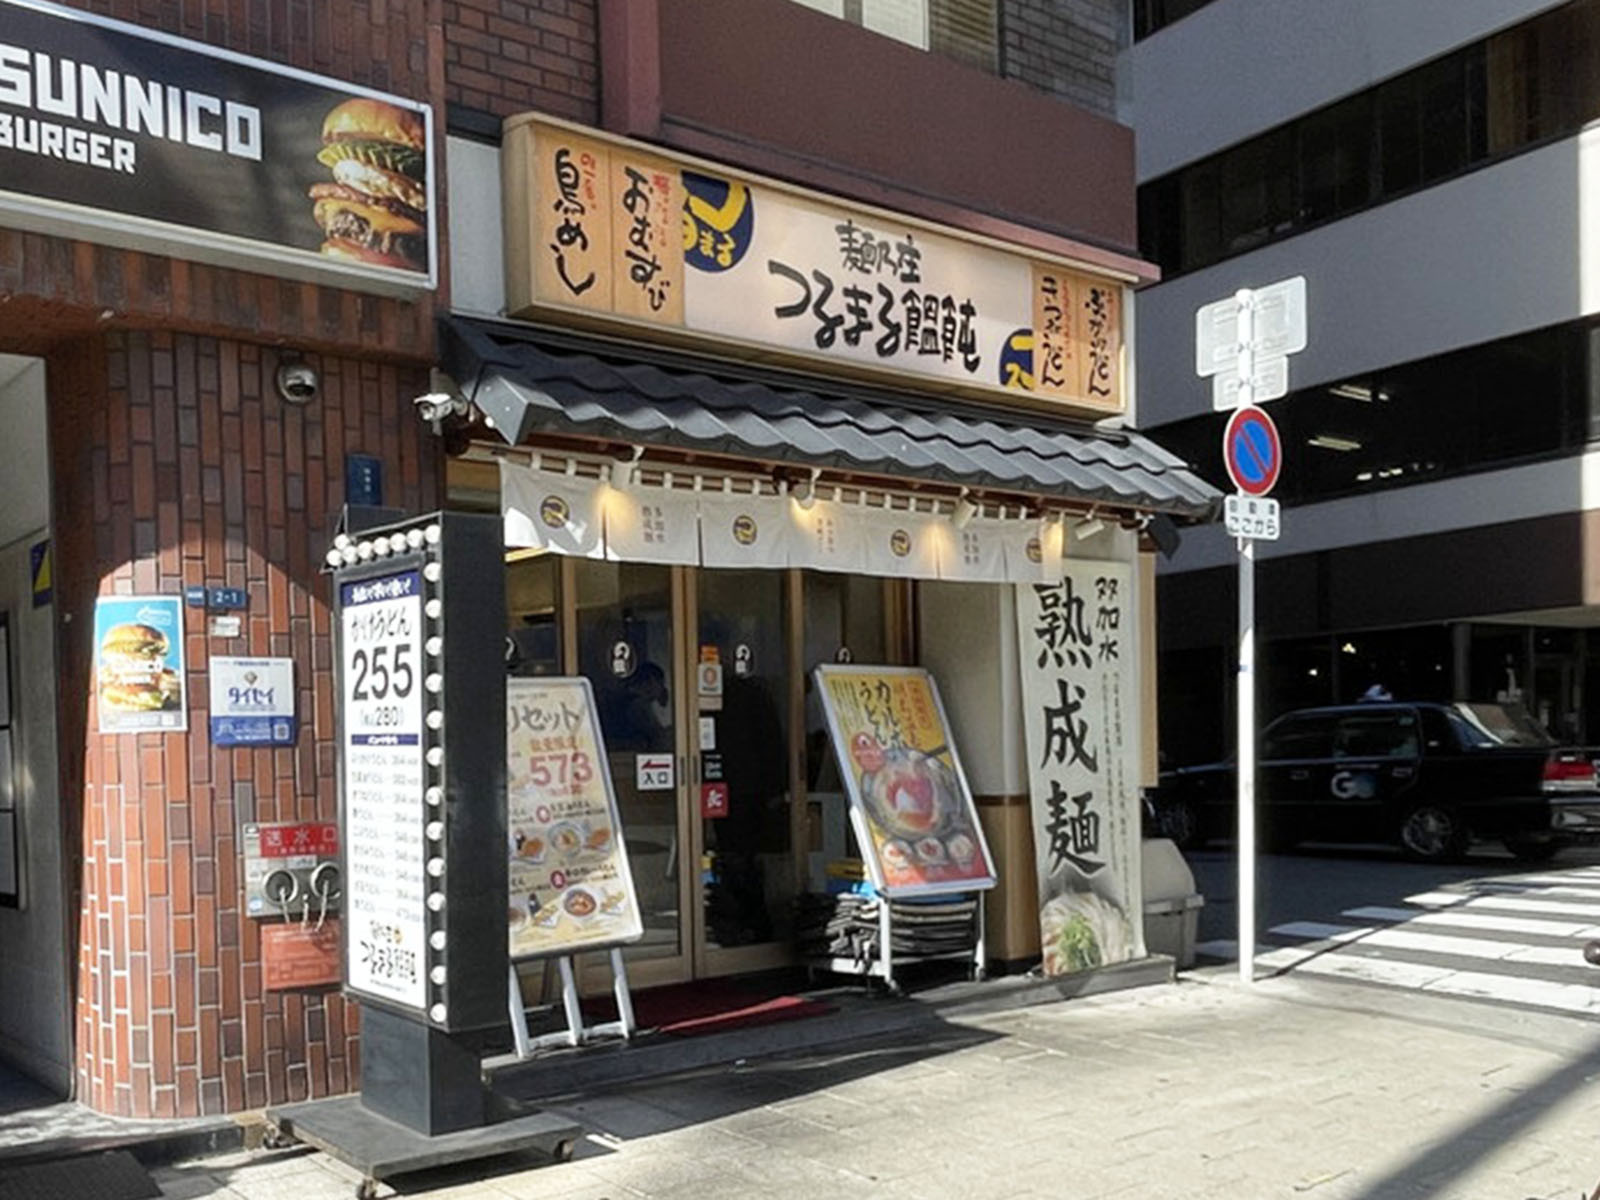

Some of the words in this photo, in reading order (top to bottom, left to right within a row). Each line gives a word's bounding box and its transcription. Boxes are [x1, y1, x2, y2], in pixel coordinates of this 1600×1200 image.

[0, 43, 263, 162] SUNNICO
[0, 112, 136, 175] BURGER
[551, 147, 596, 297] 鳥めし
[767, 259, 981, 374] つるまる饂飩
[1229, 515, 1277, 536] ここから
[215, 591, 238, 604] 2-1
[352, 643, 414, 702] 255
[1033, 574, 1107, 878] 熟成麺
[529, 751, 593, 788] 573
[643, 771, 669, 785] 入口
